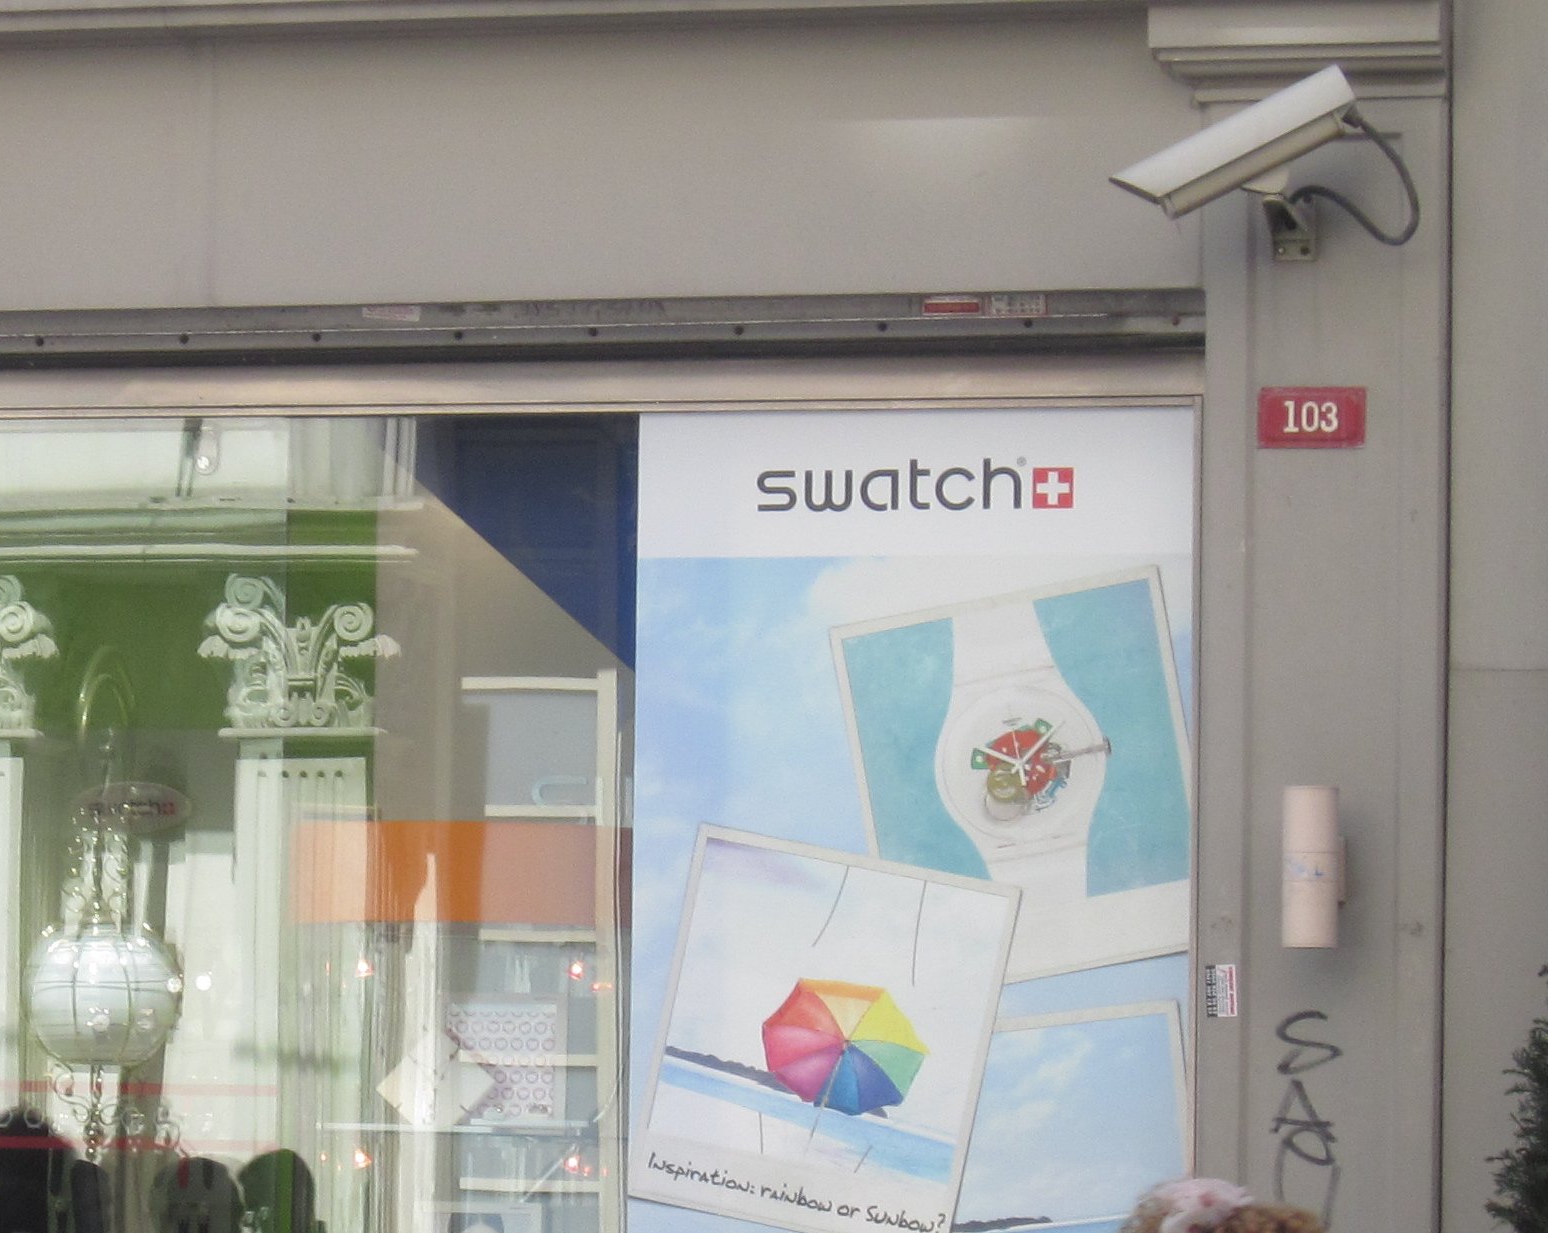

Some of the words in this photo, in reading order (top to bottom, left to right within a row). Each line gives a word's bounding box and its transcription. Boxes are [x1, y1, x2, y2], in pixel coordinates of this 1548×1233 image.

[1283, 400, 1339, 434] 103
[756, 458, 1022, 512] swatch
[648, 1152, 755, 1196] Inspiration:
[760, 1183, 833, 1213] rainbow
[837, 1203, 861, 1219] or
